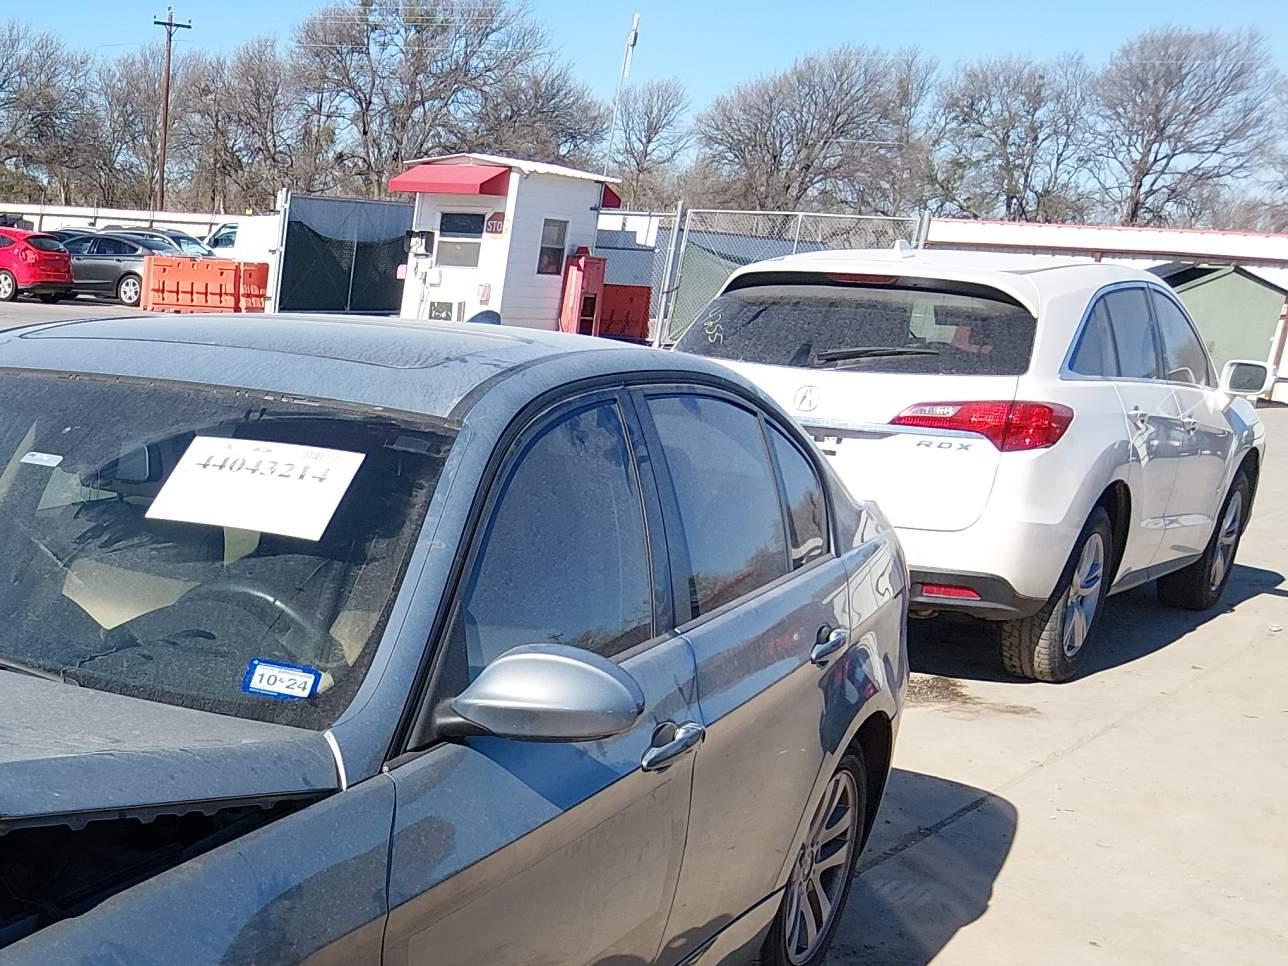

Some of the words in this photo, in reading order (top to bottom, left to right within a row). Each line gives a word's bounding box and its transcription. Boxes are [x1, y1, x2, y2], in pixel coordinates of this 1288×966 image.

[487, 220, 509, 233] STO
[916, 440, 972, 451] RDX
[196, 455, 330, 483] 44043214
